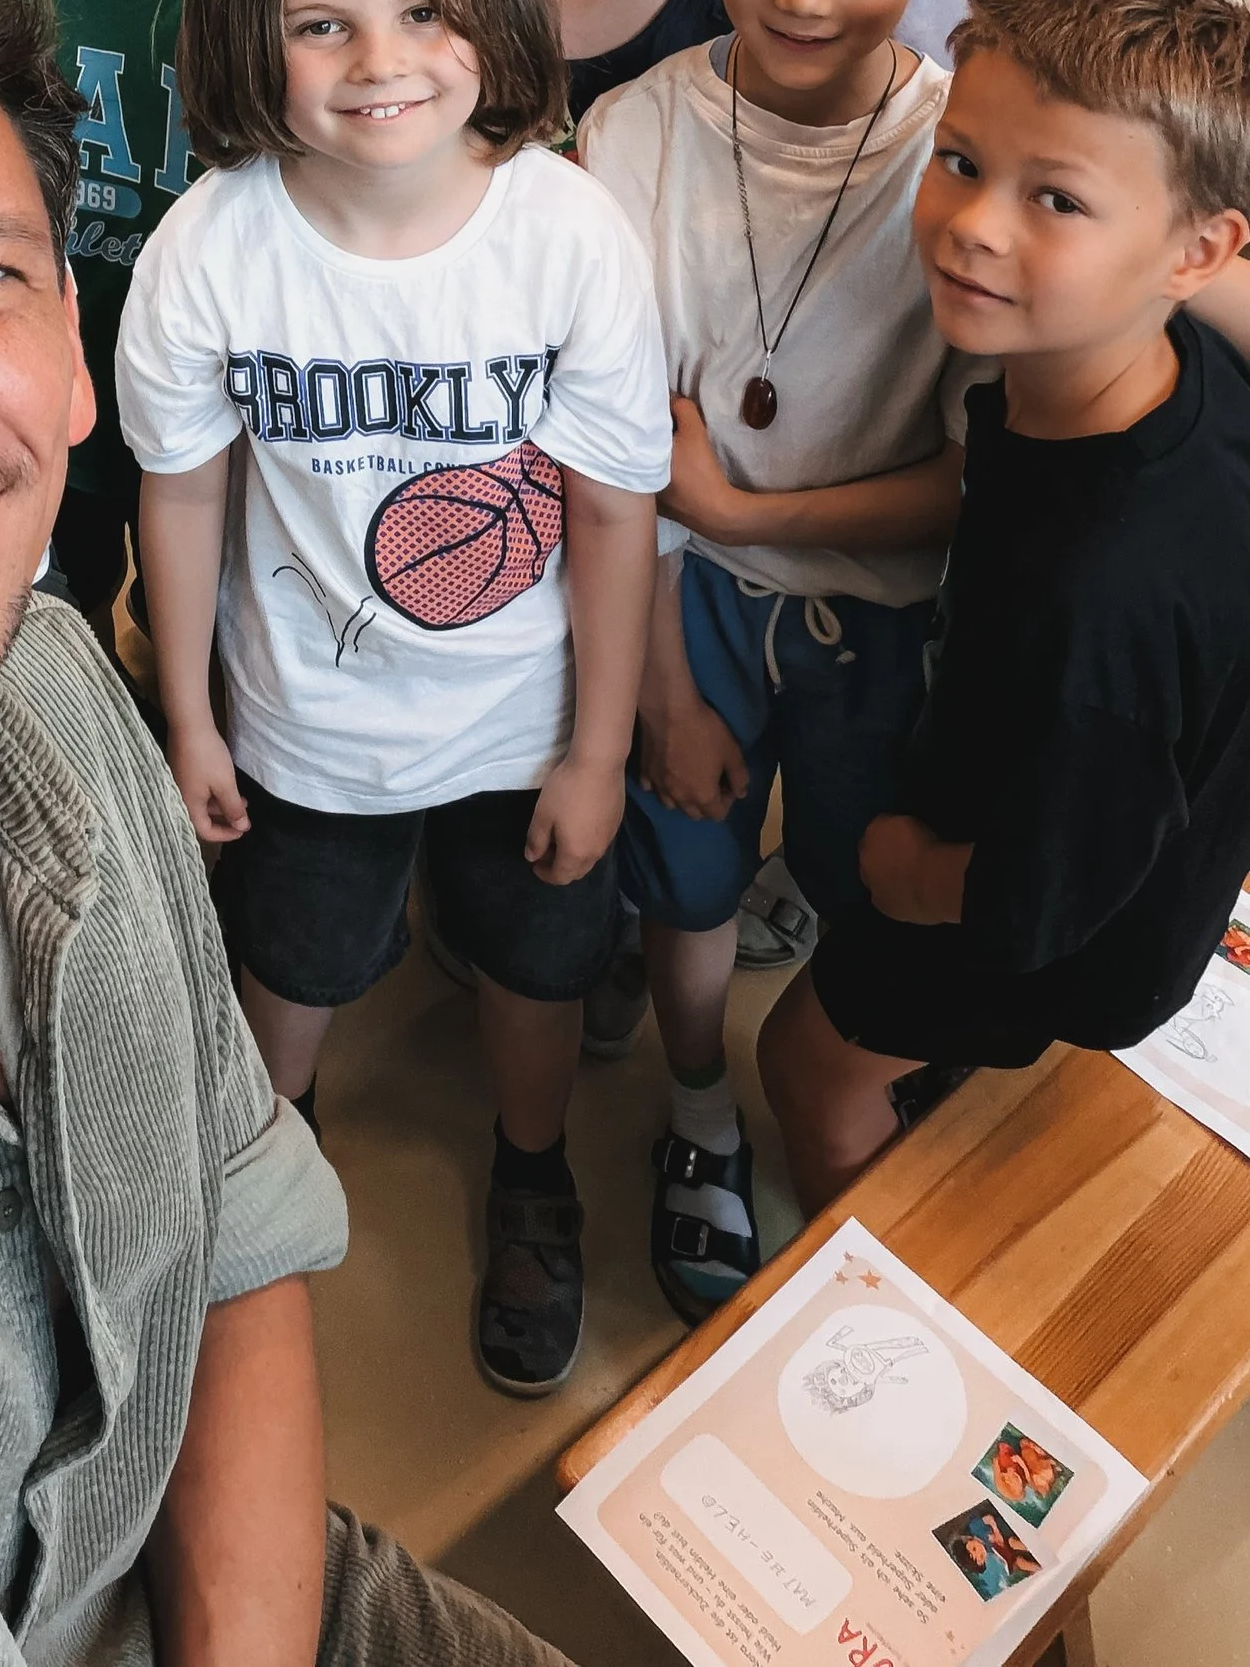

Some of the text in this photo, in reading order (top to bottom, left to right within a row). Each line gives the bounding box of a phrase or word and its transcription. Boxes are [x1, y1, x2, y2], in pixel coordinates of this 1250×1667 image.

[312, 454, 415, 475] BASKETBALL
[804, 1498, 859, 1552] Superheldin
[913, 1609, 929, 1624] So
[752, 1641, 772, 1662] Wie
